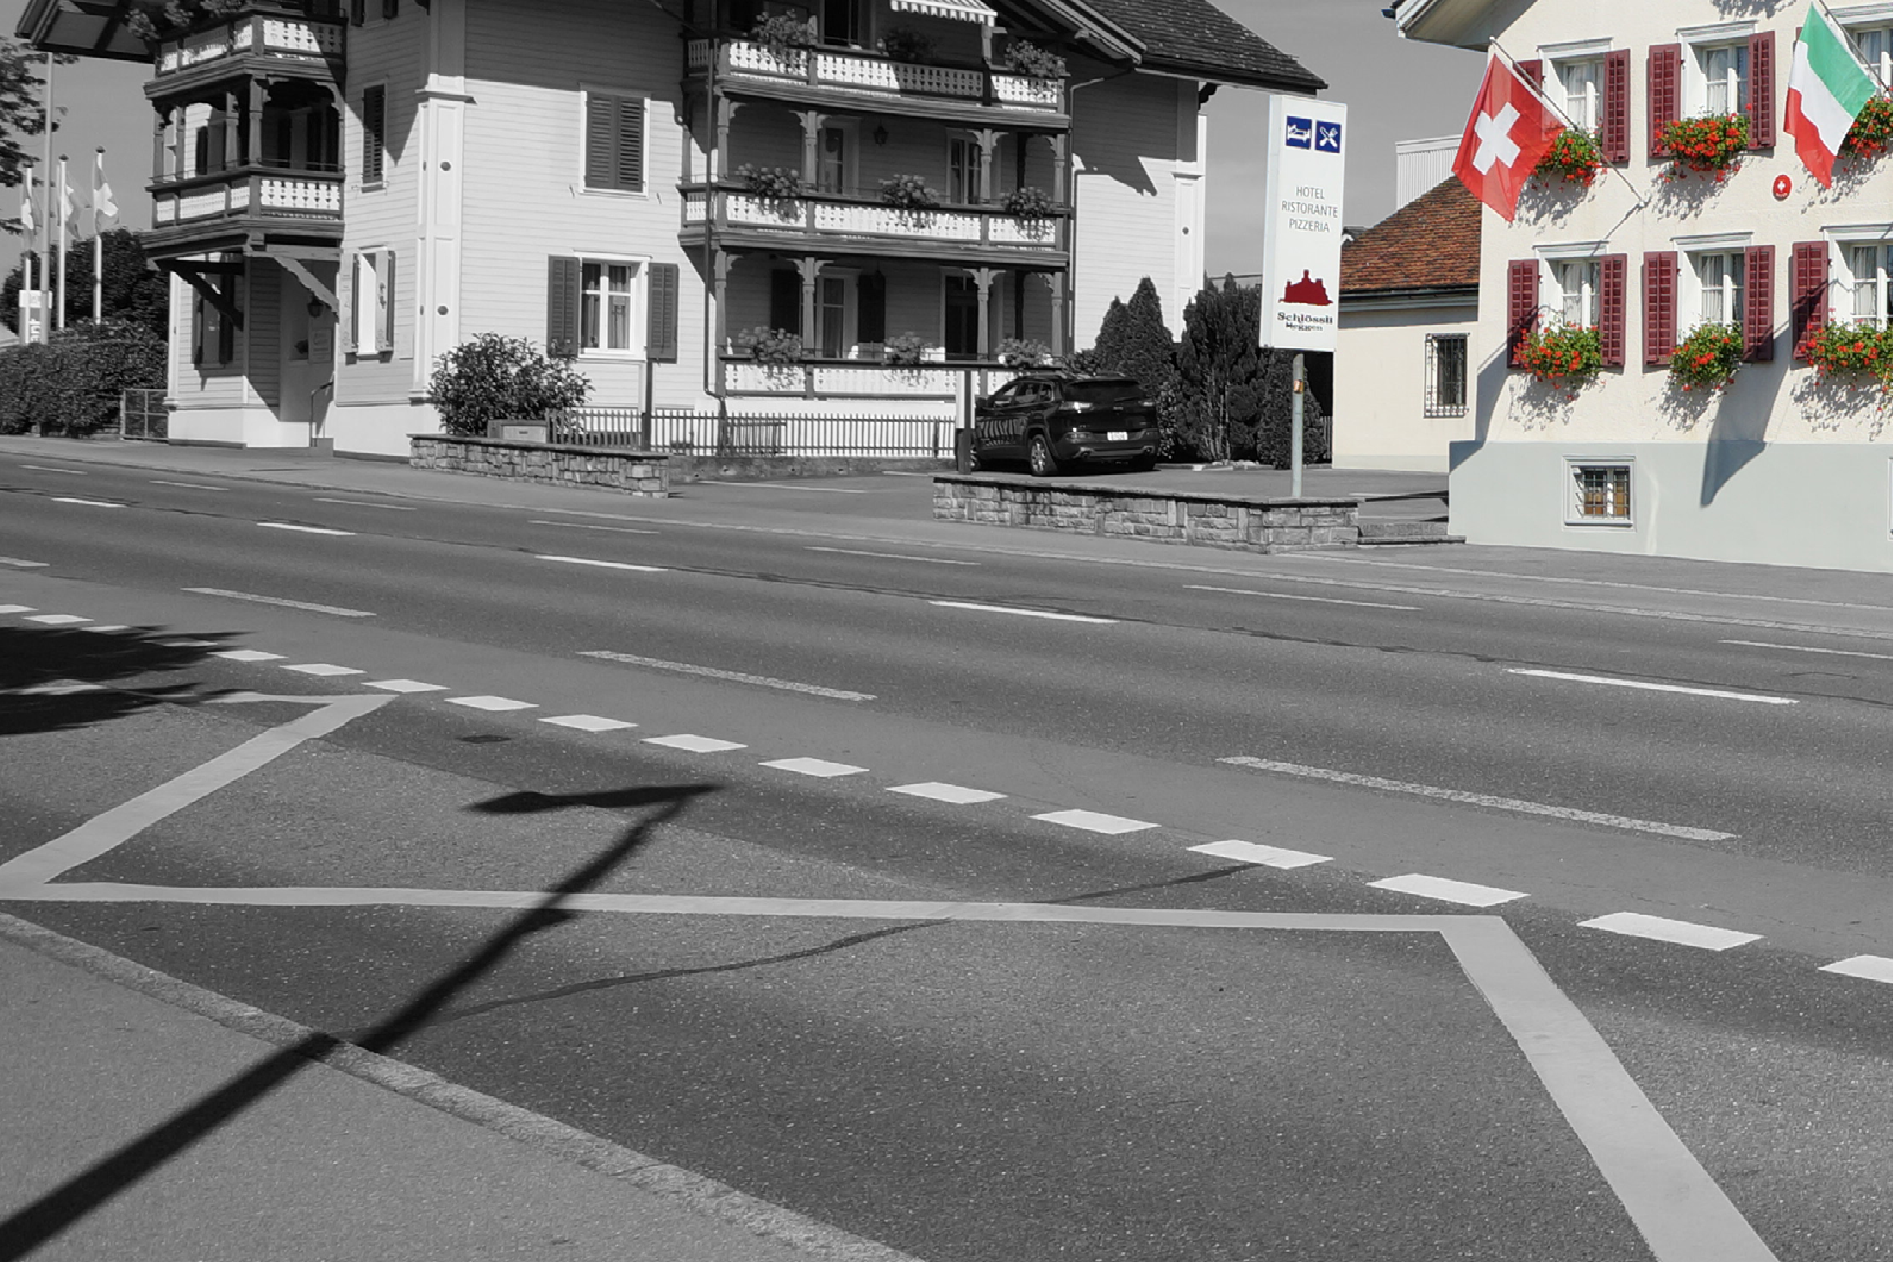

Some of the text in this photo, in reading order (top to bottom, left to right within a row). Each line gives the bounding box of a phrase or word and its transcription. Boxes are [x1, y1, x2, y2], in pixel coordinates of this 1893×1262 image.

[1295, 186, 1325, 200] HOTEL
[1281, 200, 1338, 218] RISTORANTE
[1289, 218, 1331, 233] PIZZERIA
